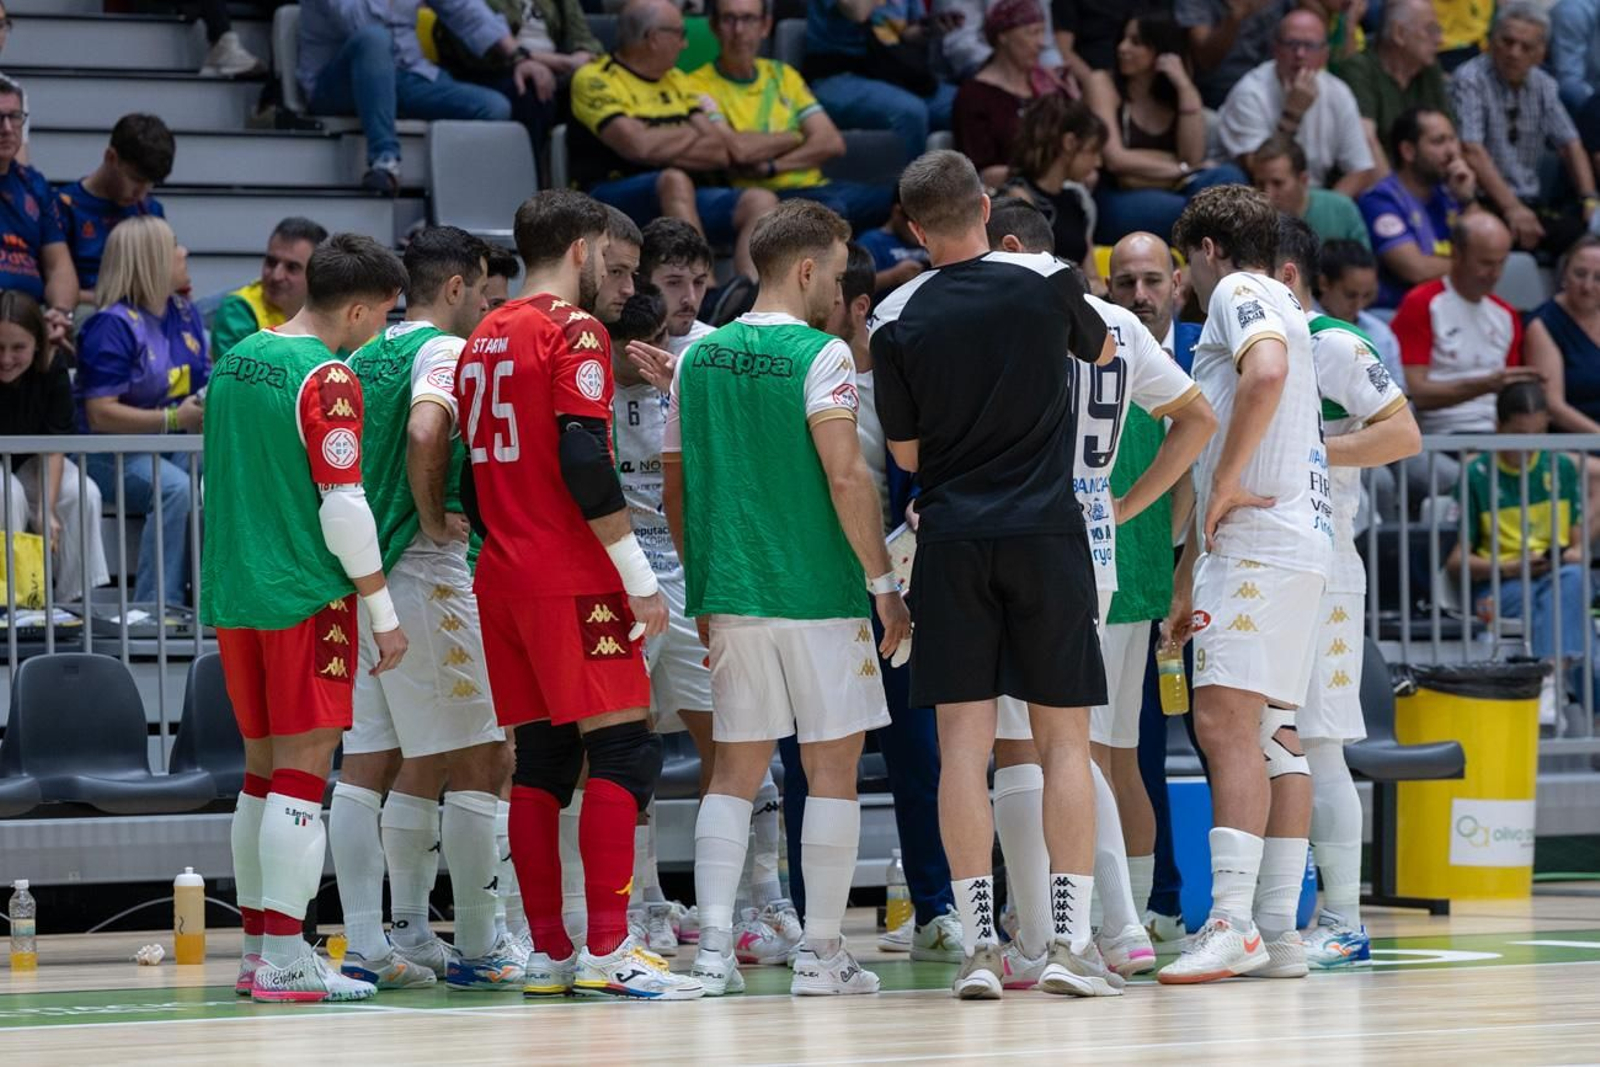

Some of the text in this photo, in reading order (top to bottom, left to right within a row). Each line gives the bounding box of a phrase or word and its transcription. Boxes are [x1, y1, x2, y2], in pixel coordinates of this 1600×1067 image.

[693, 344, 793, 377] Kappa
[460, 360, 520, 463] 25
[627, 401, 640, 426] 6
[1073, 477, 1109, 493] BANCA
[634, 527, 671, 538] eputac
[1196, 648, 1206, 671] 9
